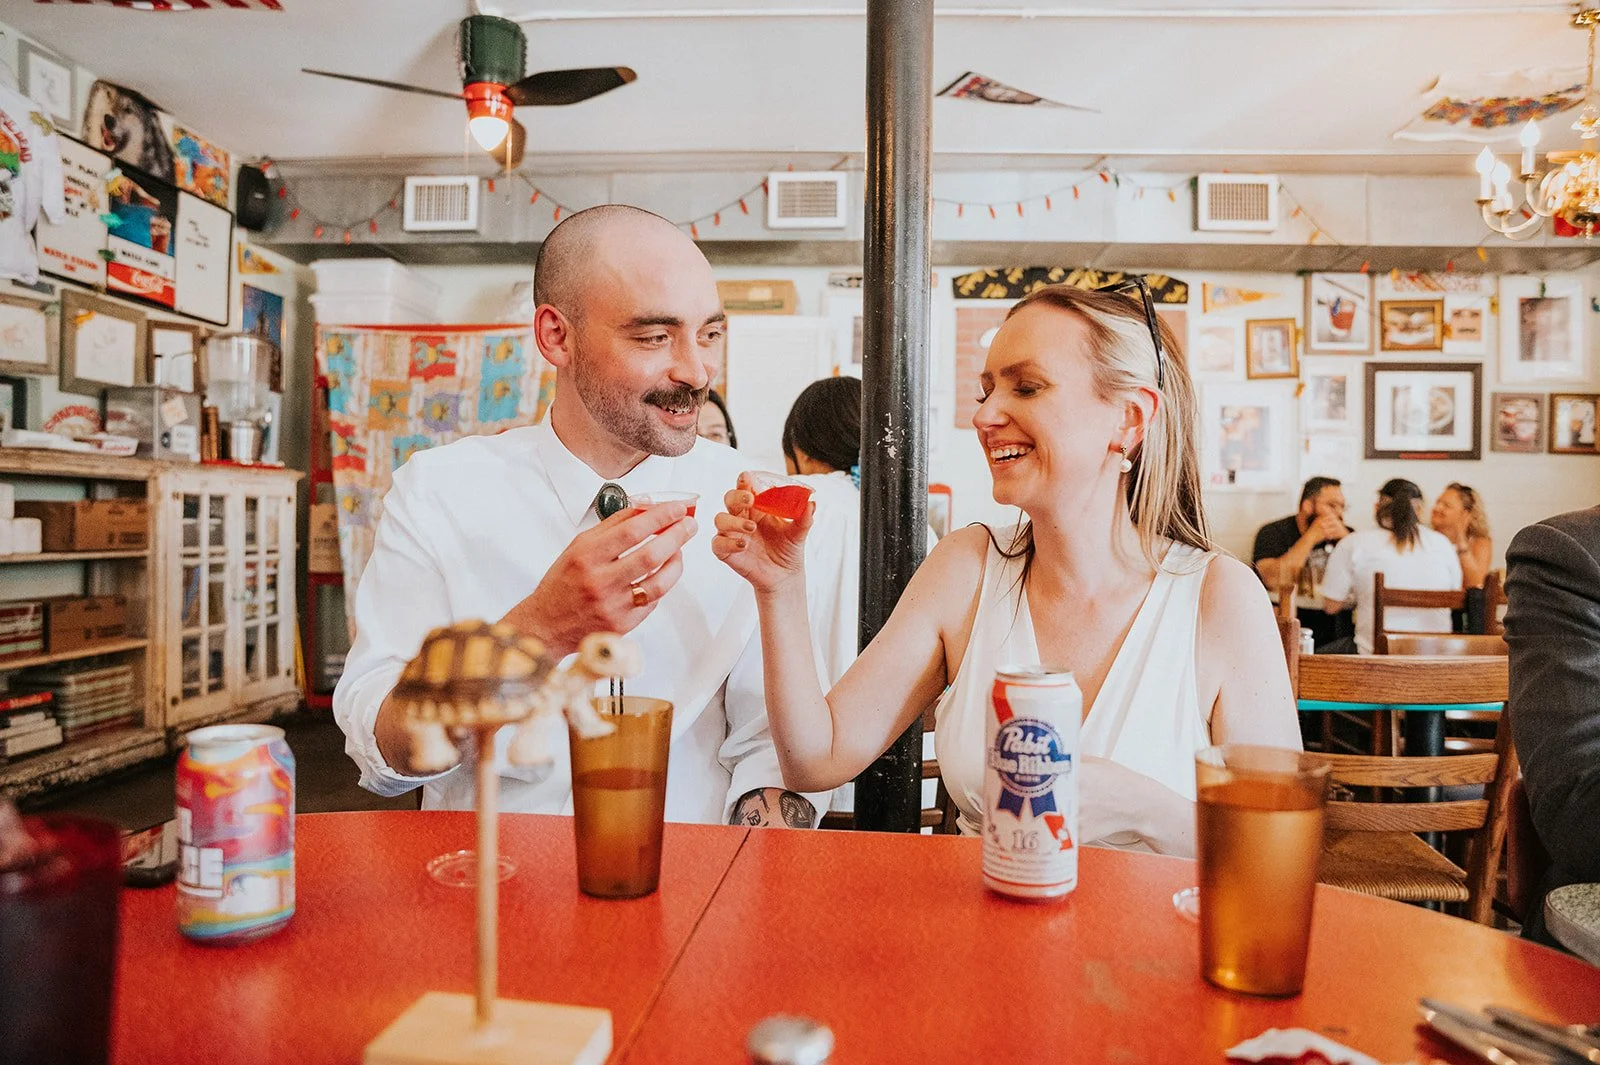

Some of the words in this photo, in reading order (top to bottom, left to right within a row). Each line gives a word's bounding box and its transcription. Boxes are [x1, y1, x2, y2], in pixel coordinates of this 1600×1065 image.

[1002, 726, 1051, 754] Pabst
[1018, 755, 1070, 775] Ribb
[1011, 829, 1039, 850] 16
